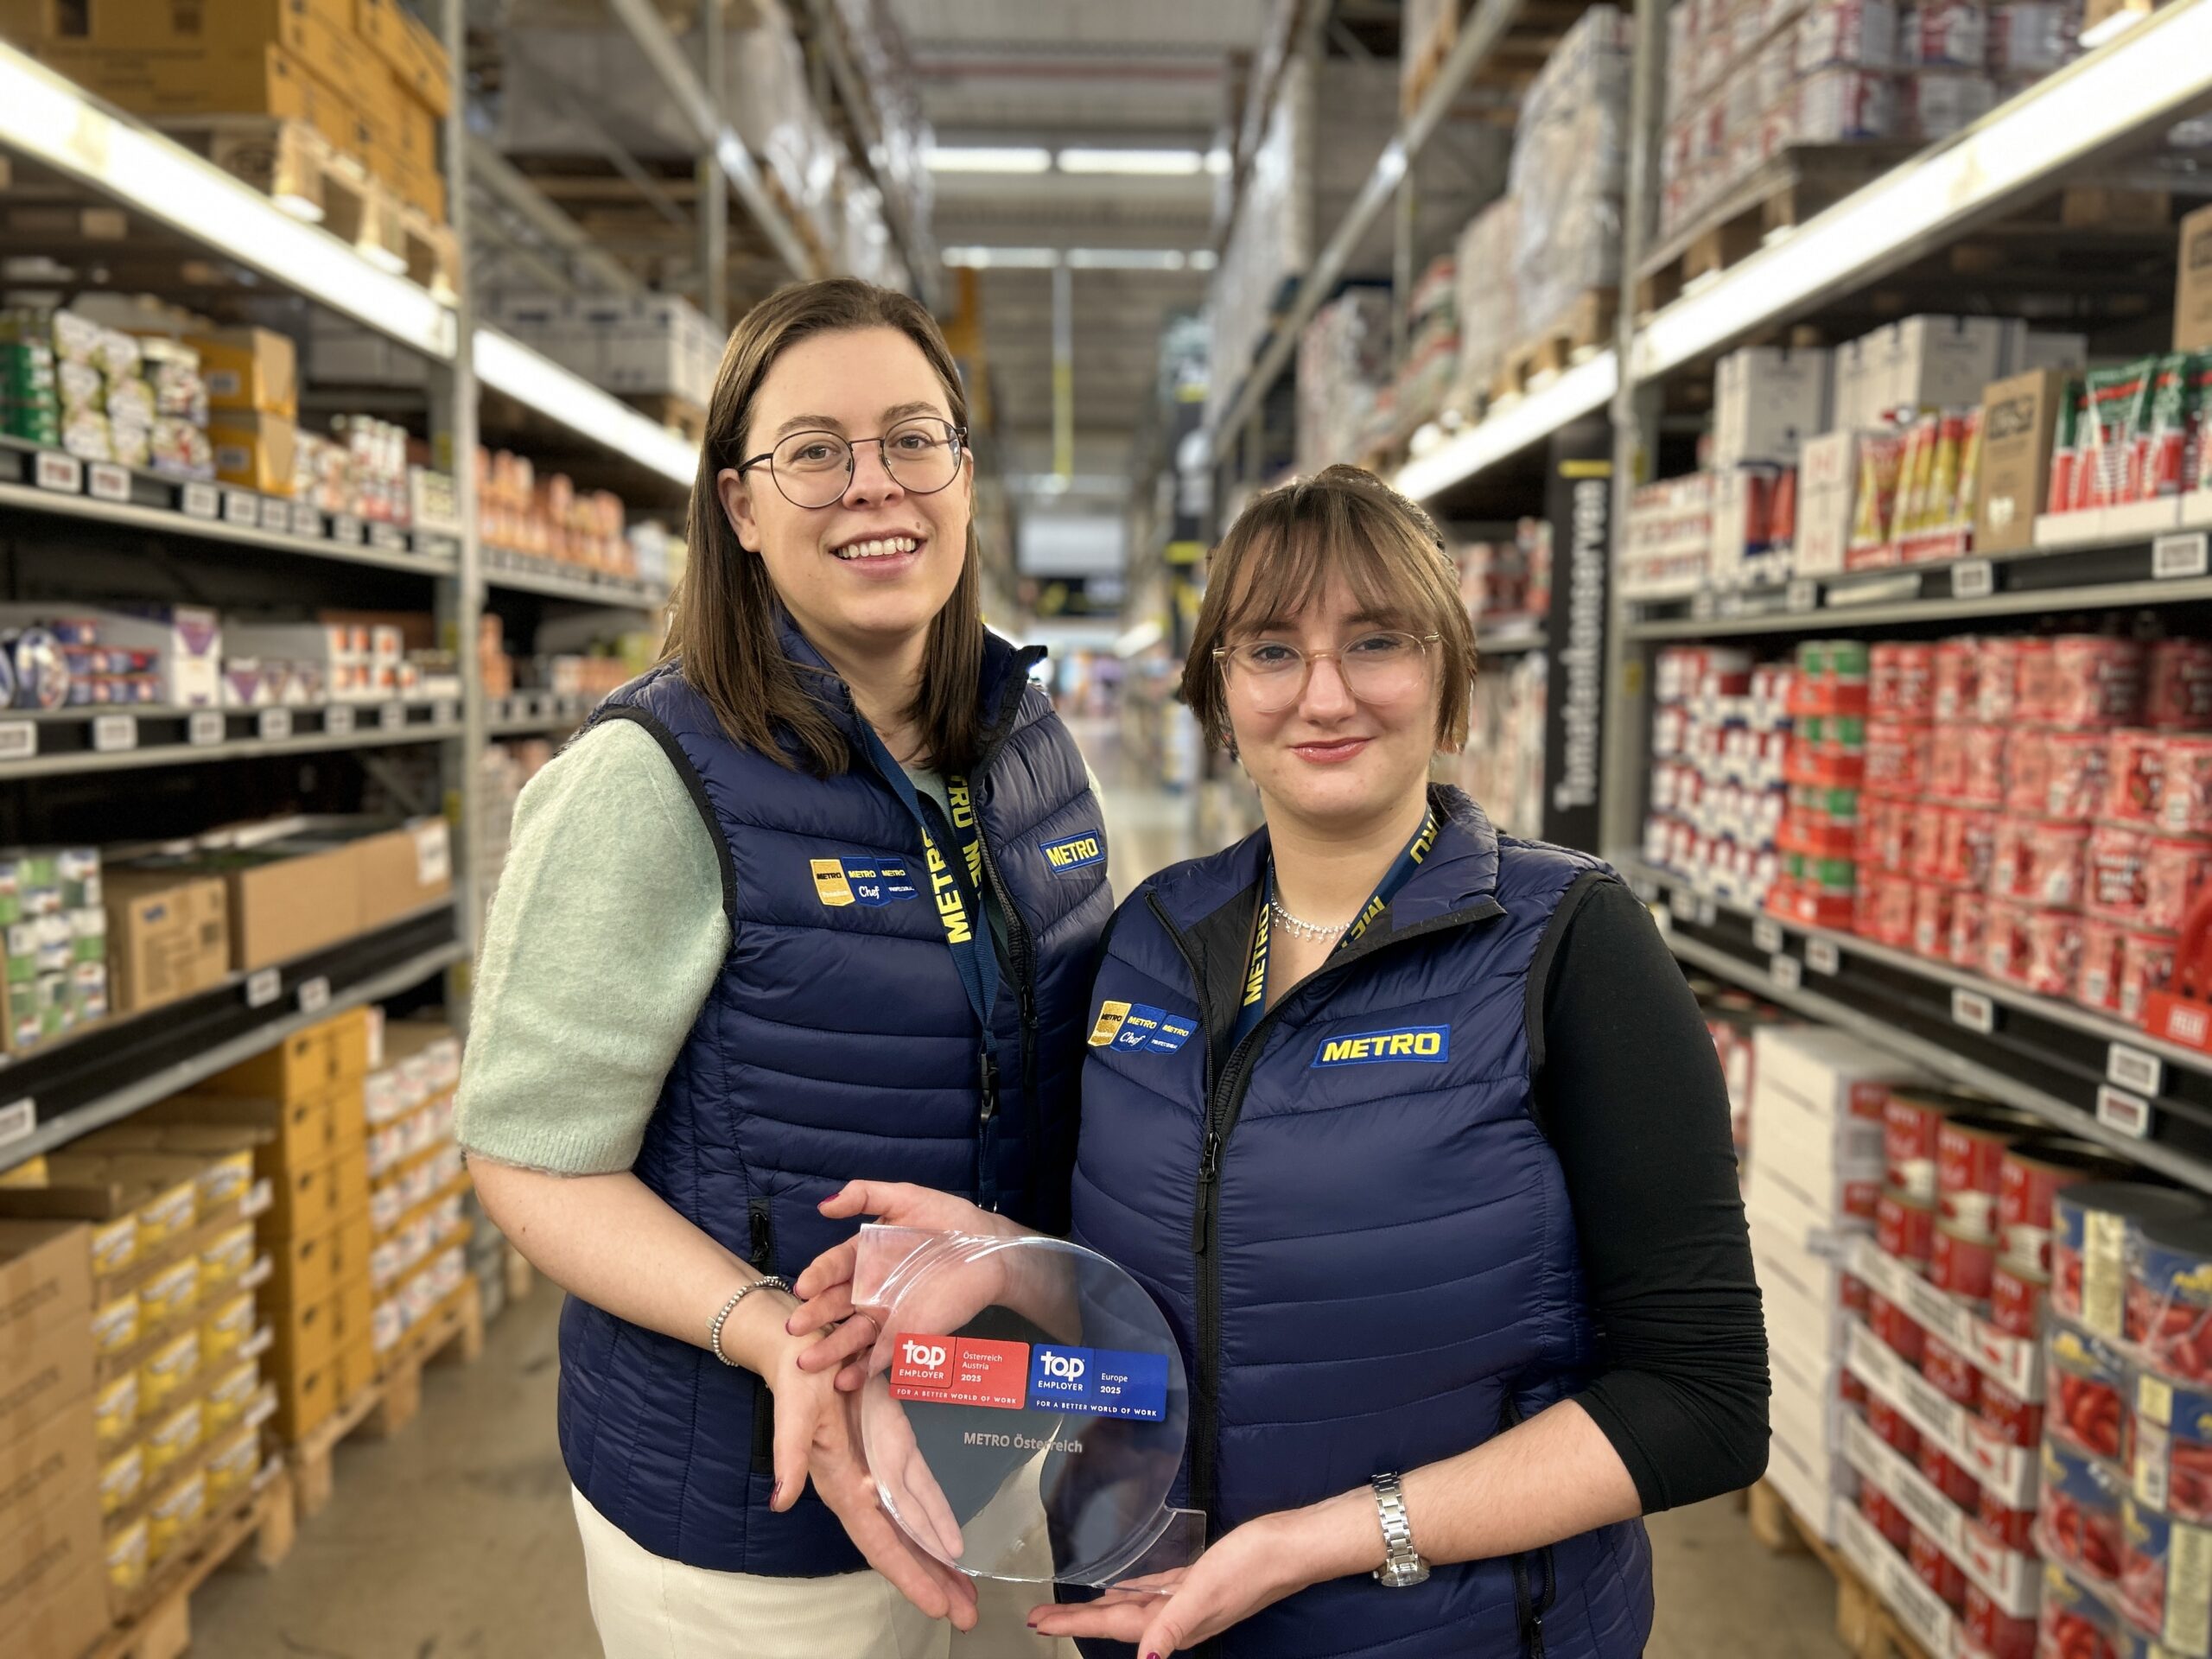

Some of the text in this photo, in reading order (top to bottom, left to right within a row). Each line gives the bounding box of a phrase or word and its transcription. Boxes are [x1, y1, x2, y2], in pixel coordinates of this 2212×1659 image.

[1046, 837, 1099, 867] METRO
[858, 886, 880, 899] Chef
[1243, 903, 1269, 1007] METRO
[1101, 1013, 1122, 1021] METRO
[1127, 1016, 1157, 1029] METRO
[1162, 1024, 1189, 1037] METRO
[1119, 1032, 1146, 1046] Chef
[1322, 1032, 1441, 1062] METRO
[902, 1340, 946, 1370] top
[963, 1351, 1002, 1362] Österreich
[962, 1362, 989, 1370] Austria
[1040, 1351, 1084, 1382] top
[899, 1369, 944, 1379] EMPLOYER
[961, 1374, 982, 1382] 2025
[1101, 1373, 1128, 1383] Europe
[1038, 1381, 1084, 1391] EMPLOYER
[963, 1432, 1083, 1452] METRO Österreich
